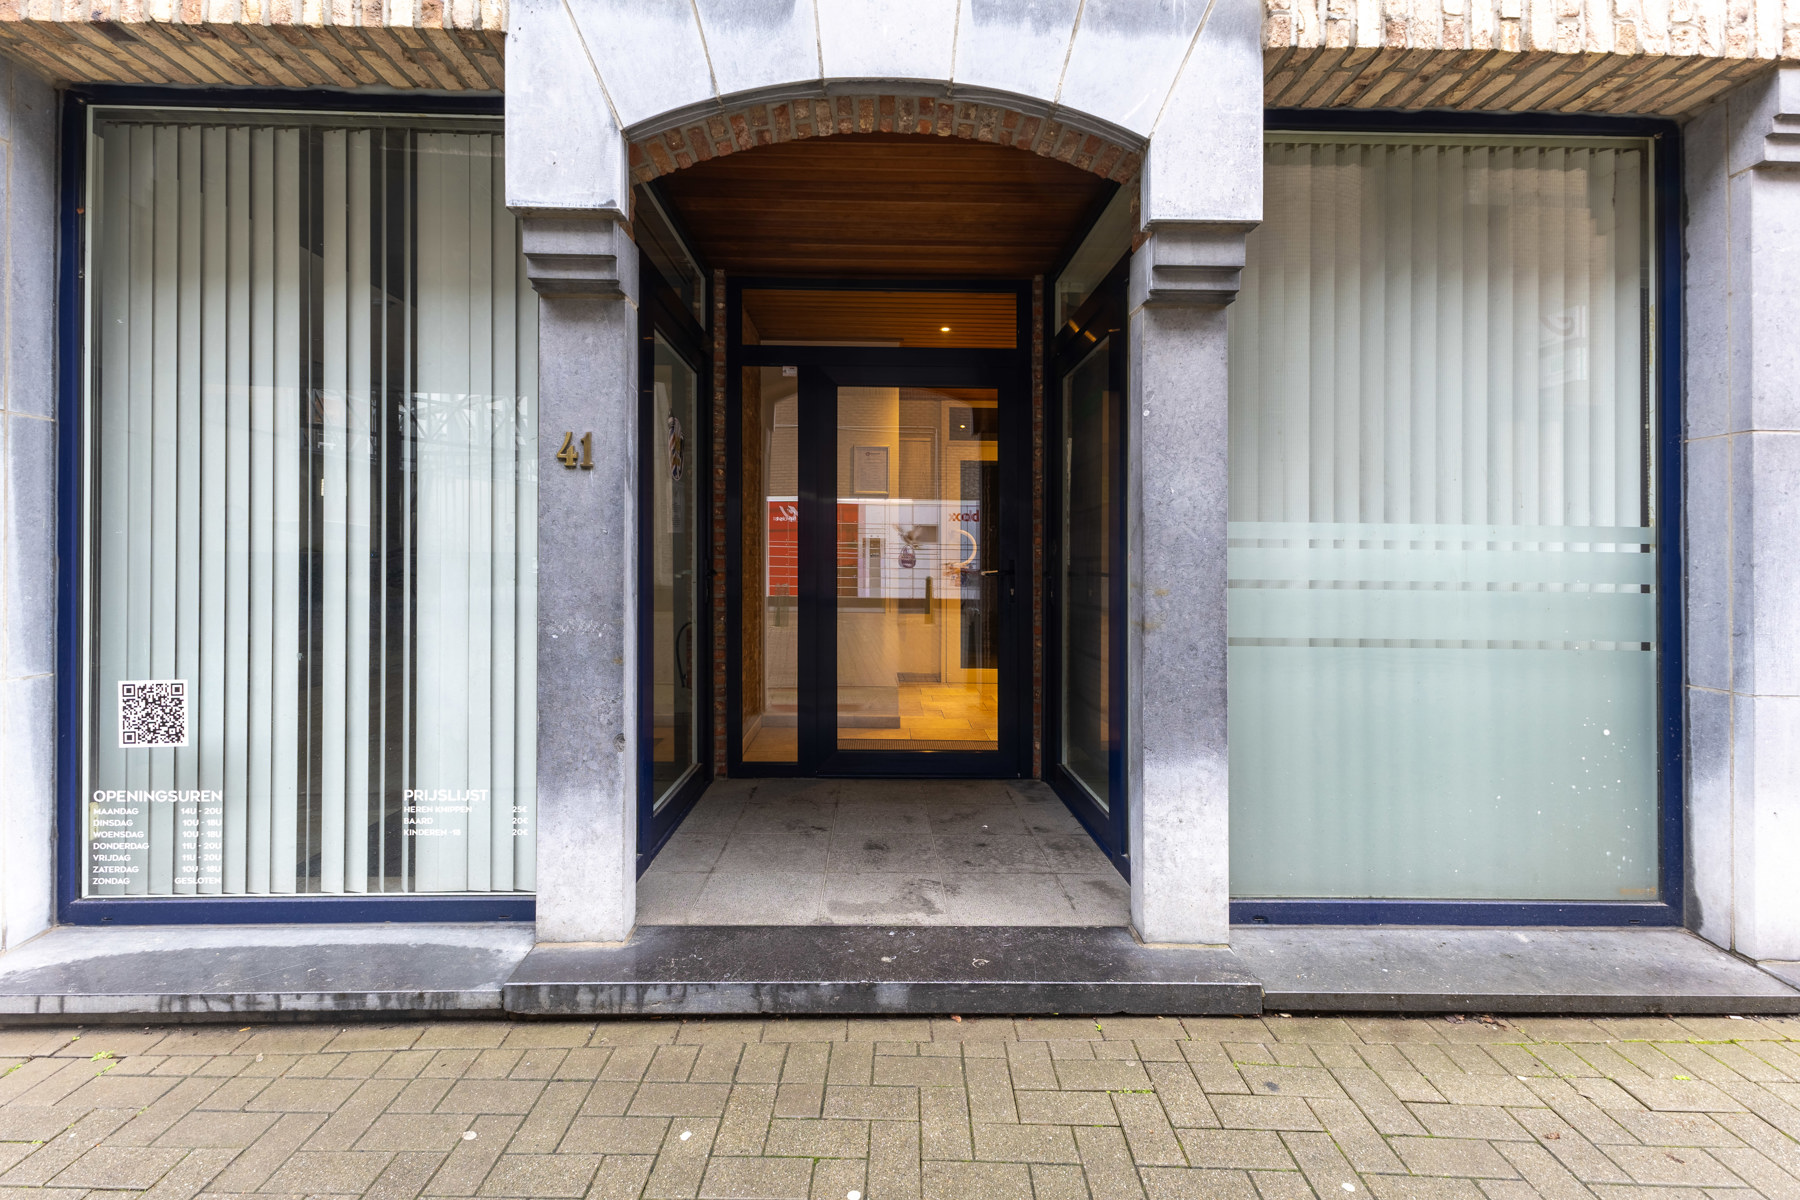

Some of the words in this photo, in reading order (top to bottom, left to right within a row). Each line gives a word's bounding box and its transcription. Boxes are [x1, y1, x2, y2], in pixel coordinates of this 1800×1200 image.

[556, 431, 594, 469] 41
[93, 790, 223, 802] OPENINGSUREN
[403, 789, 488, 801] PRIJSLIJST
[93, 807, 139, 815] MAANDAG
[180, 807, 197, 815] 14U
[203, 807, 222, 815] 20U
[403, 805, 433, 813] HEREN
[434, 805, 472, 813] KNIPPEN
[511, 805, 528, 813] 25€
[93, 819, 134, 827] DINSDAG
[182, 819, 199, 827] 10U
[403, 817, 434, 825] BAARD
[511, 817, 528, 825] 20€
[511, 828, 528, 836] 20€
[93, 842, 149, 850] DONDERDAG
[181, 842, 196, 850] 11U
[203, 842, 222, 850] 20U
[93, 877, 131, 885] ZONDAG
[174, 877, 221, 885] GESLOTEN
